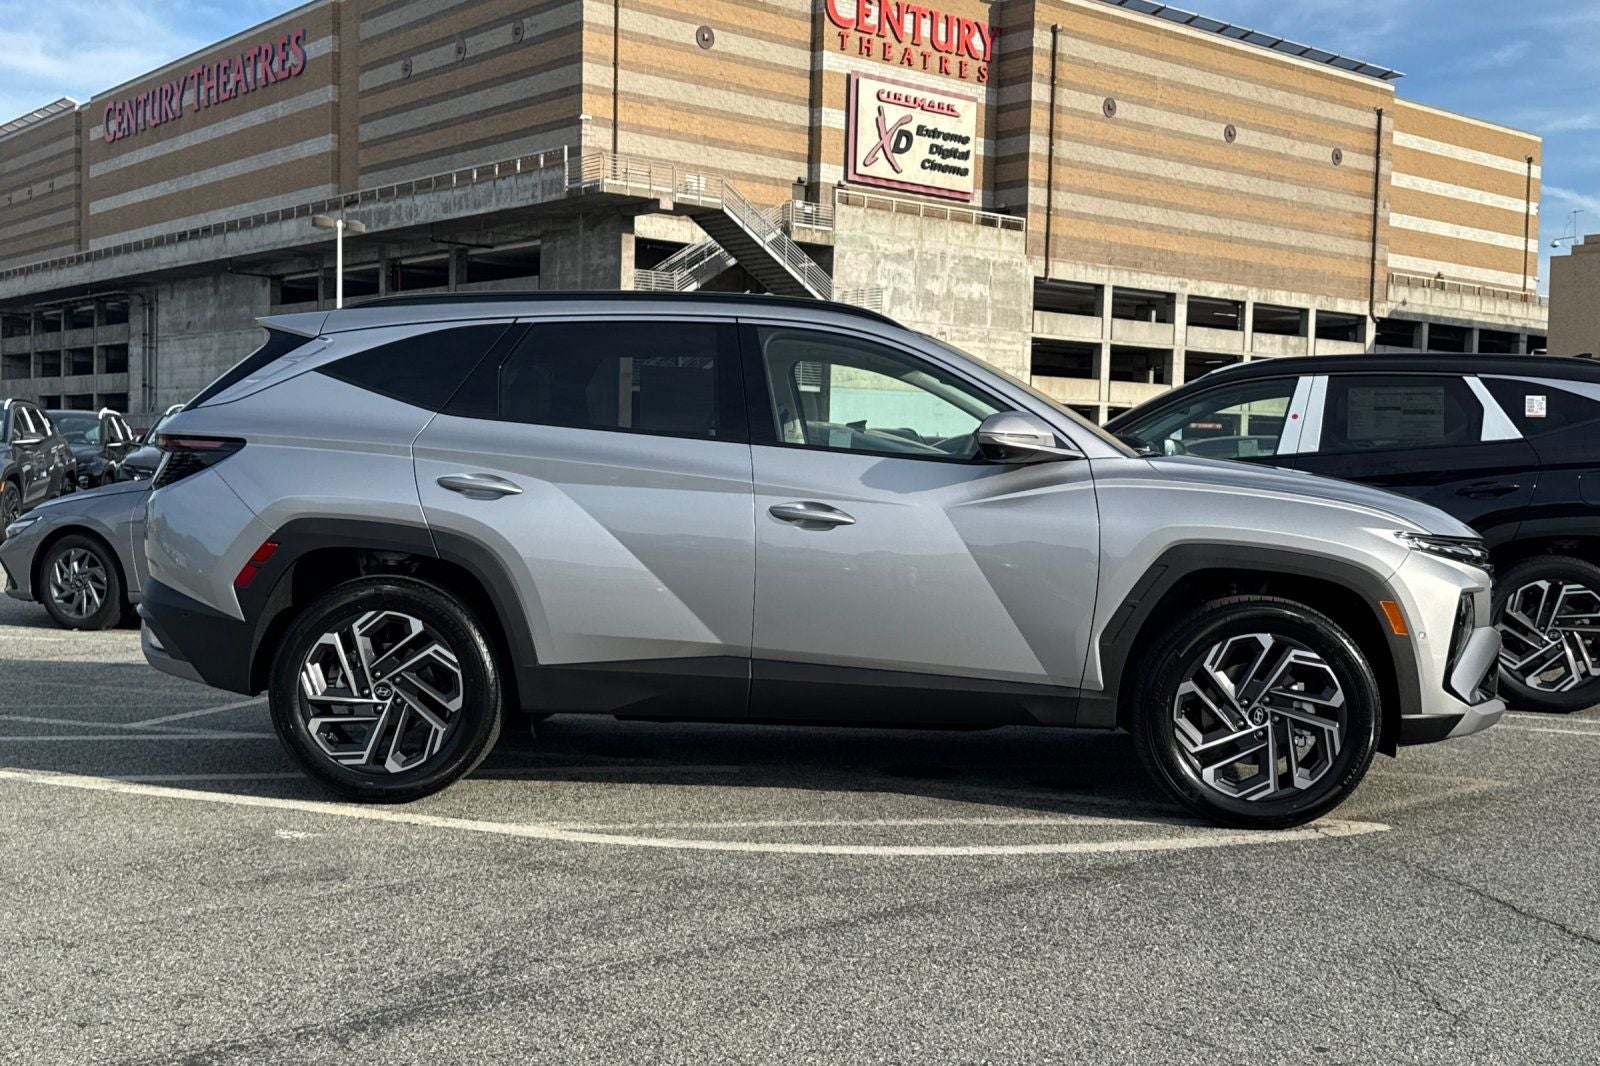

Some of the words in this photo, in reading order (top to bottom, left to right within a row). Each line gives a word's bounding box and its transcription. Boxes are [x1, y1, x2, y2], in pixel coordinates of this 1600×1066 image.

[825, 0, 999, 62] CENTURY
[838, 32, 988, 82] THEATRES
[102, 76, 187, 143] CENTURY
[190, 27, 307, 112] THEATRES
[877, 89, 959, 115] CINEMARK
[916, 124, 971, 145] Extreme
[929, 143, 971, 162] Digital
[921, 158, 969, 177] Cinema
